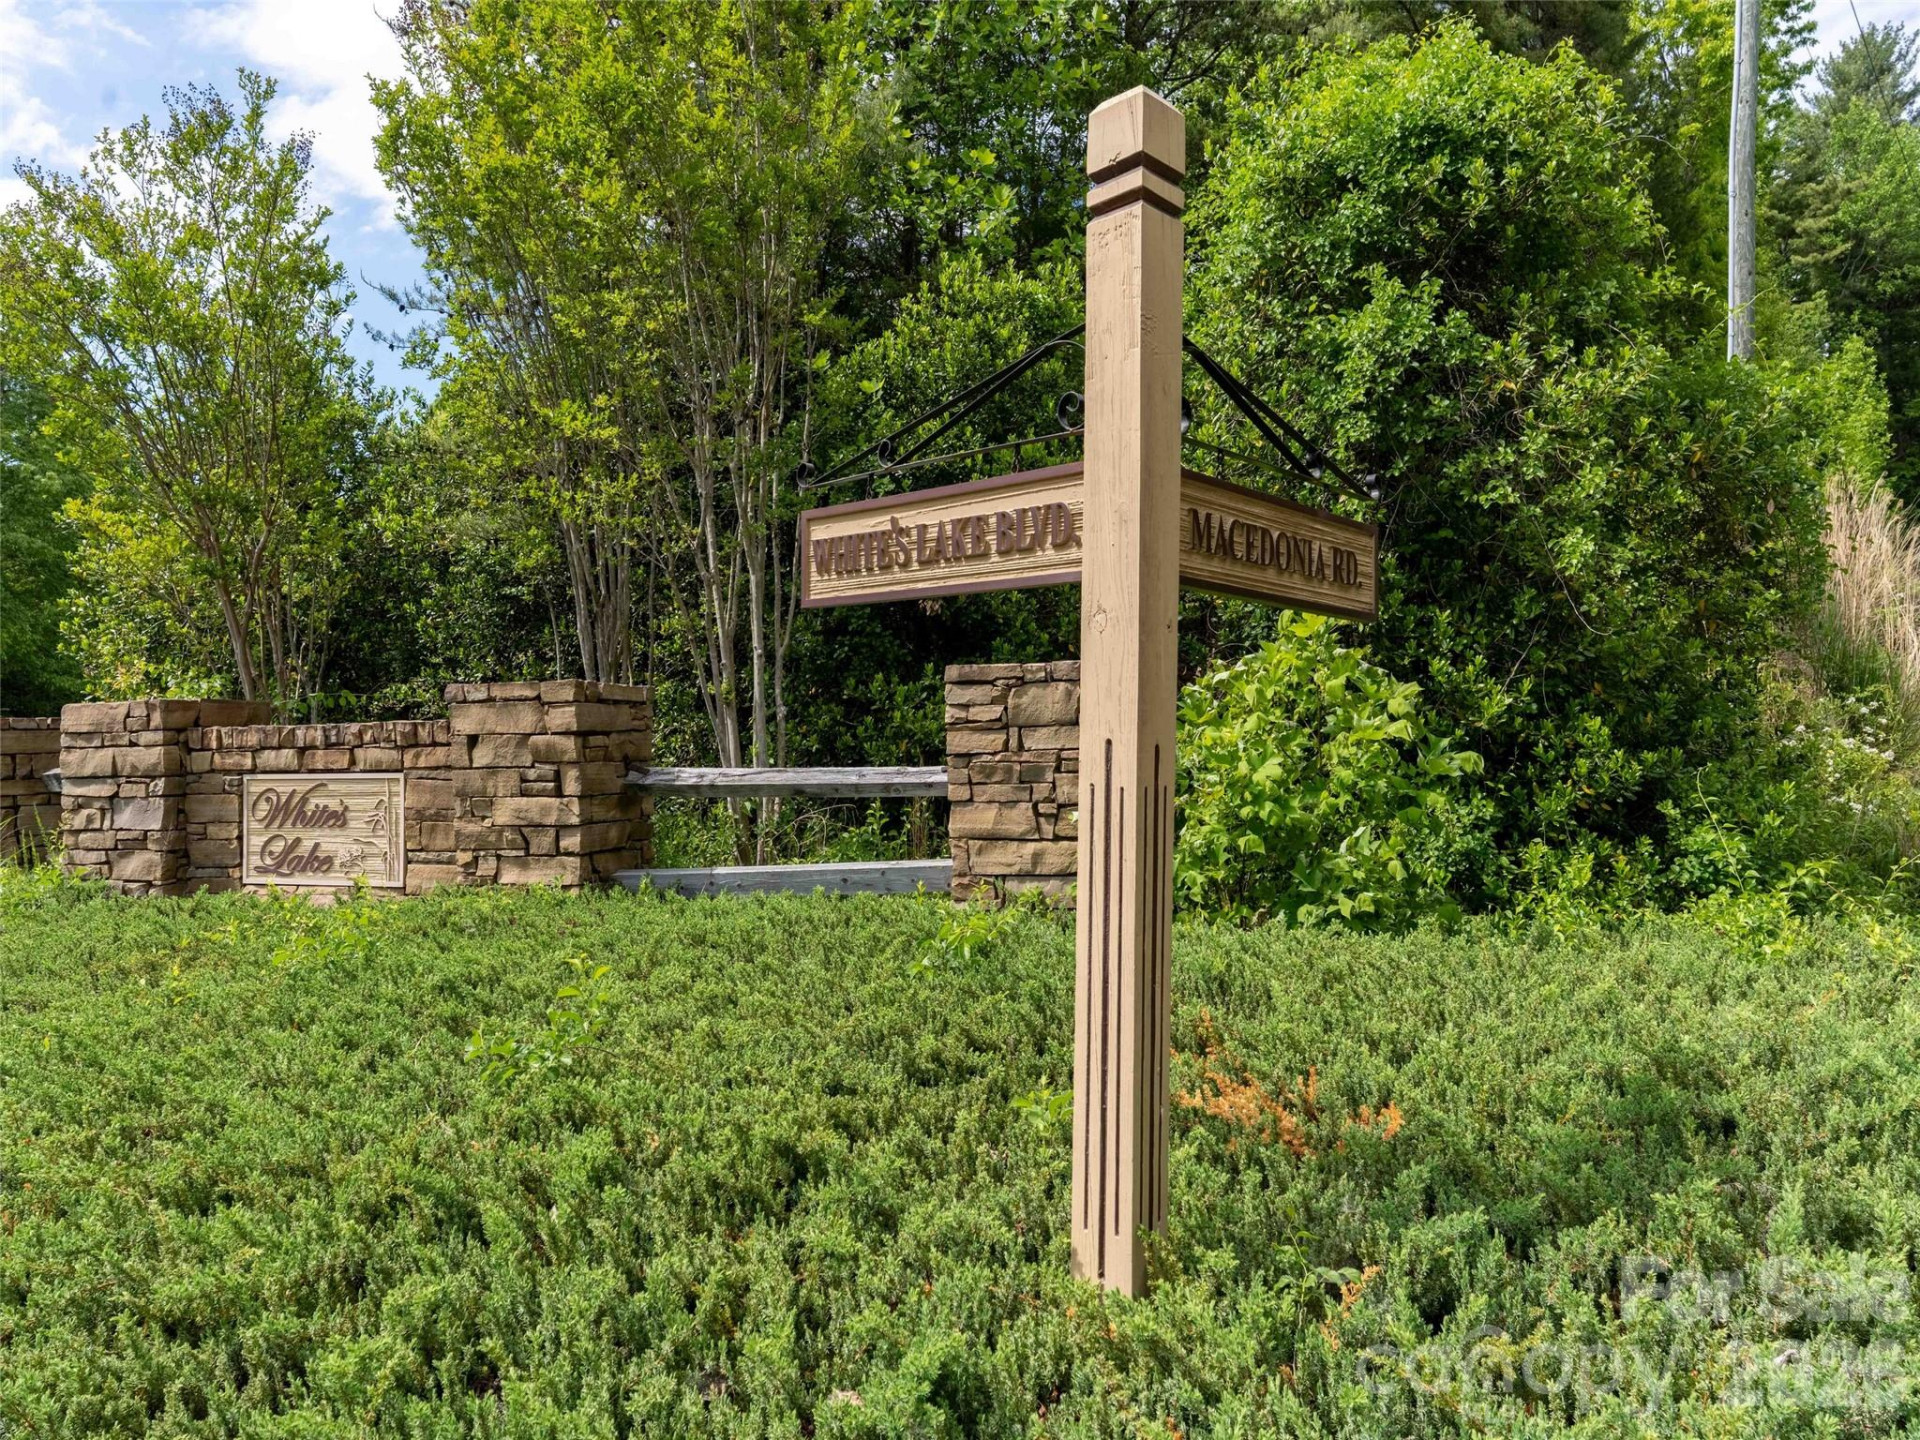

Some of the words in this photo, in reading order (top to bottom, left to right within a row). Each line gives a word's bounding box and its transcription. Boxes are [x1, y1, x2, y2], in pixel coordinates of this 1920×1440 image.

[812, 515, 913, 576] WHITE'S
[915, 513, 991, 564] LAKE
[995, 501, 1083, 554] BLVD.
[1188, 507, 1325, 581] MACEDONIA
[1330, 546, 1363, 588] RD.
[252, 782, 350, 829] White's
[253, 833, 334, 876] Lake
